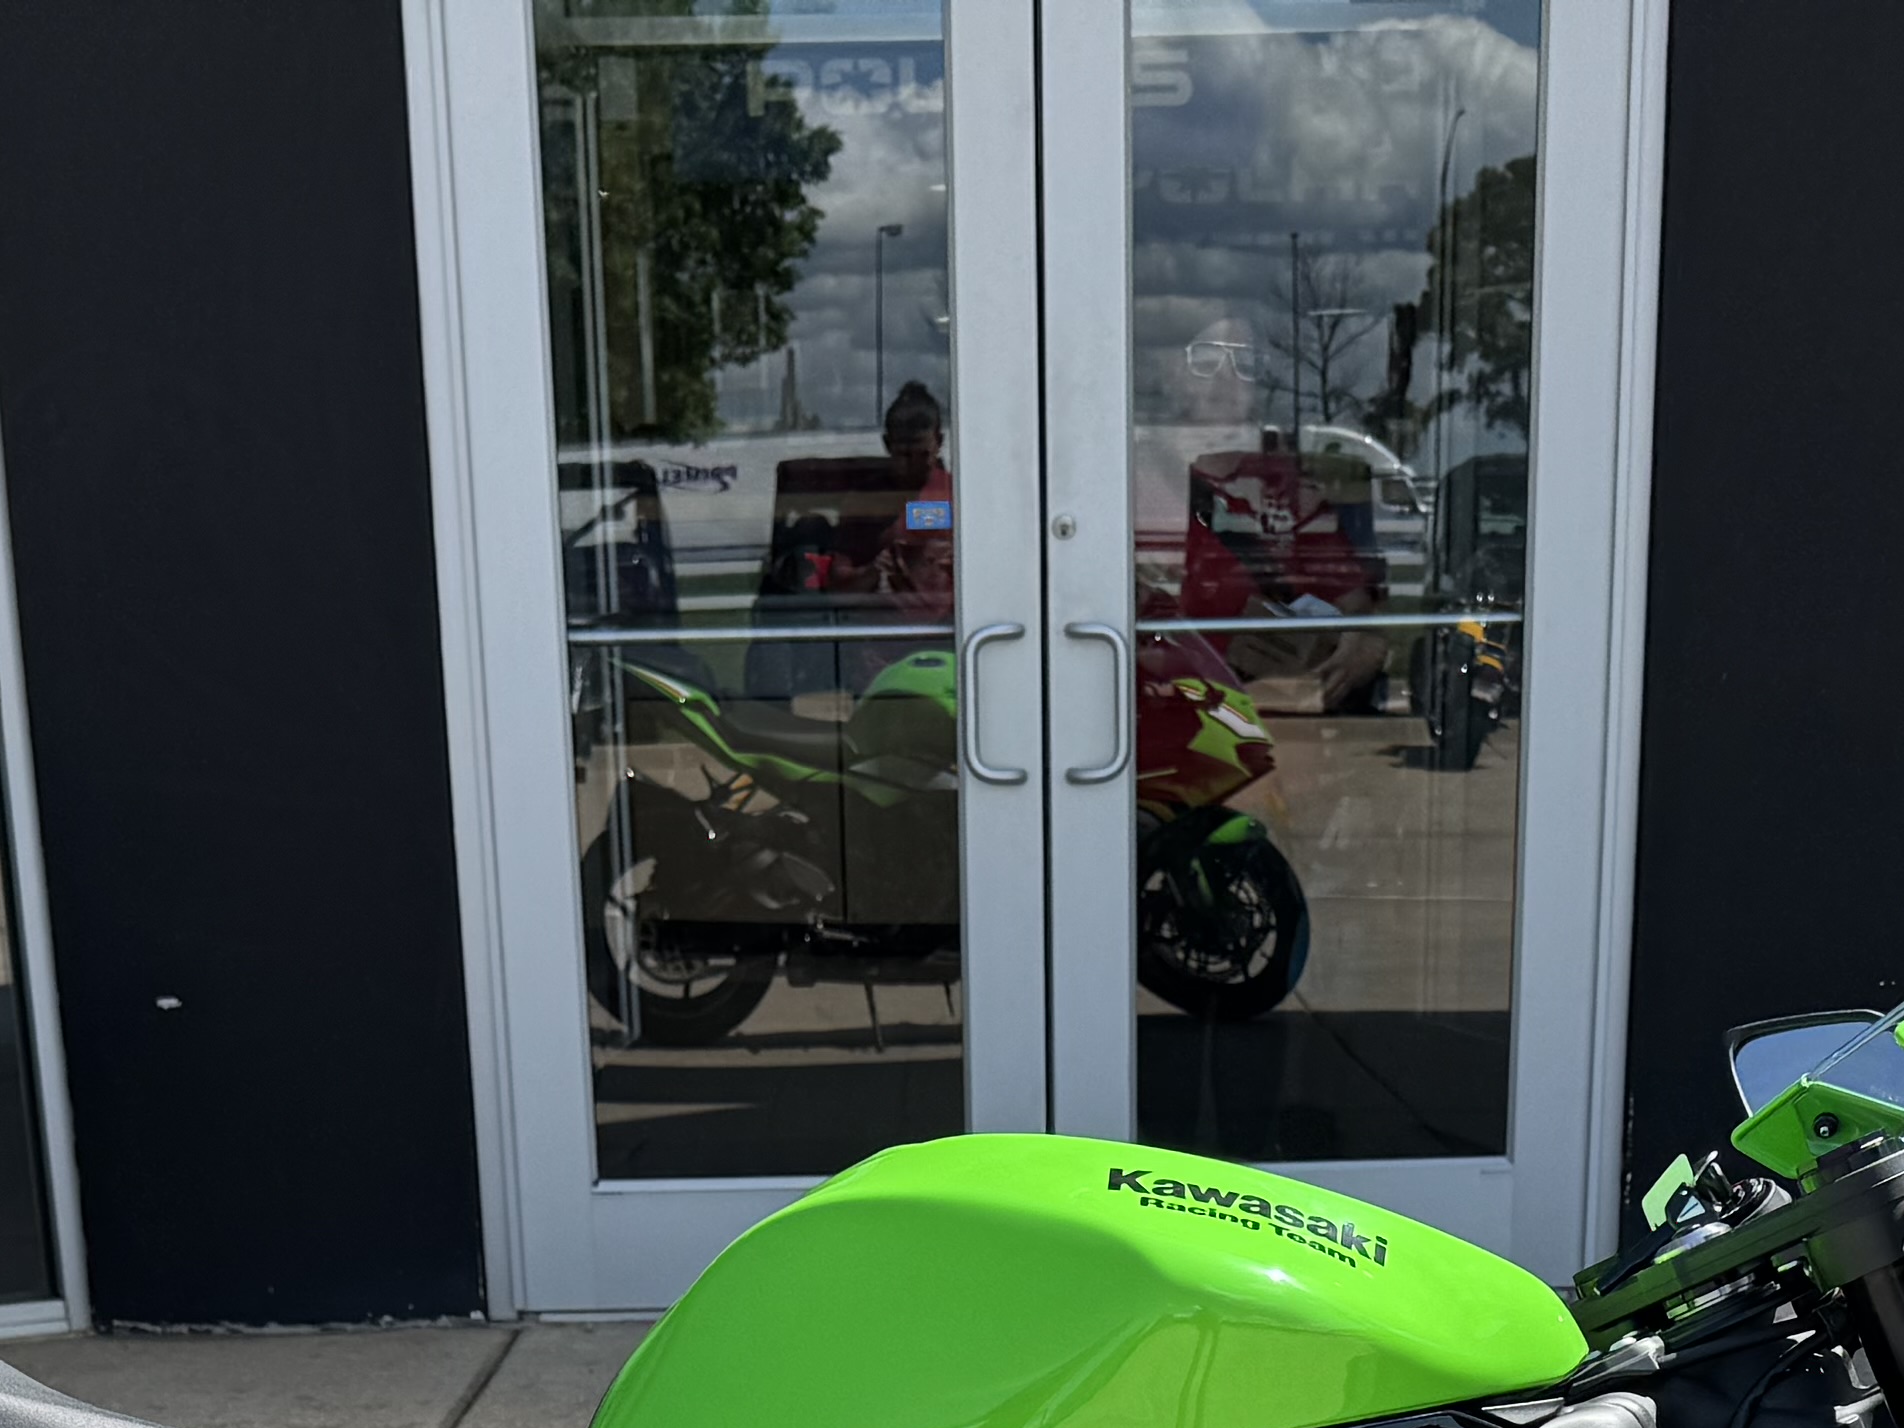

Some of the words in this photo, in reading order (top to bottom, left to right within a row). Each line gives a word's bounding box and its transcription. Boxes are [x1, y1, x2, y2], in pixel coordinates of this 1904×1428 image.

[1107, 1168, 1388, 1267] Kawasaki
[1139, 1196, 1261, 1231] Racing
[1268, 1222, 1357, 1268] Team
